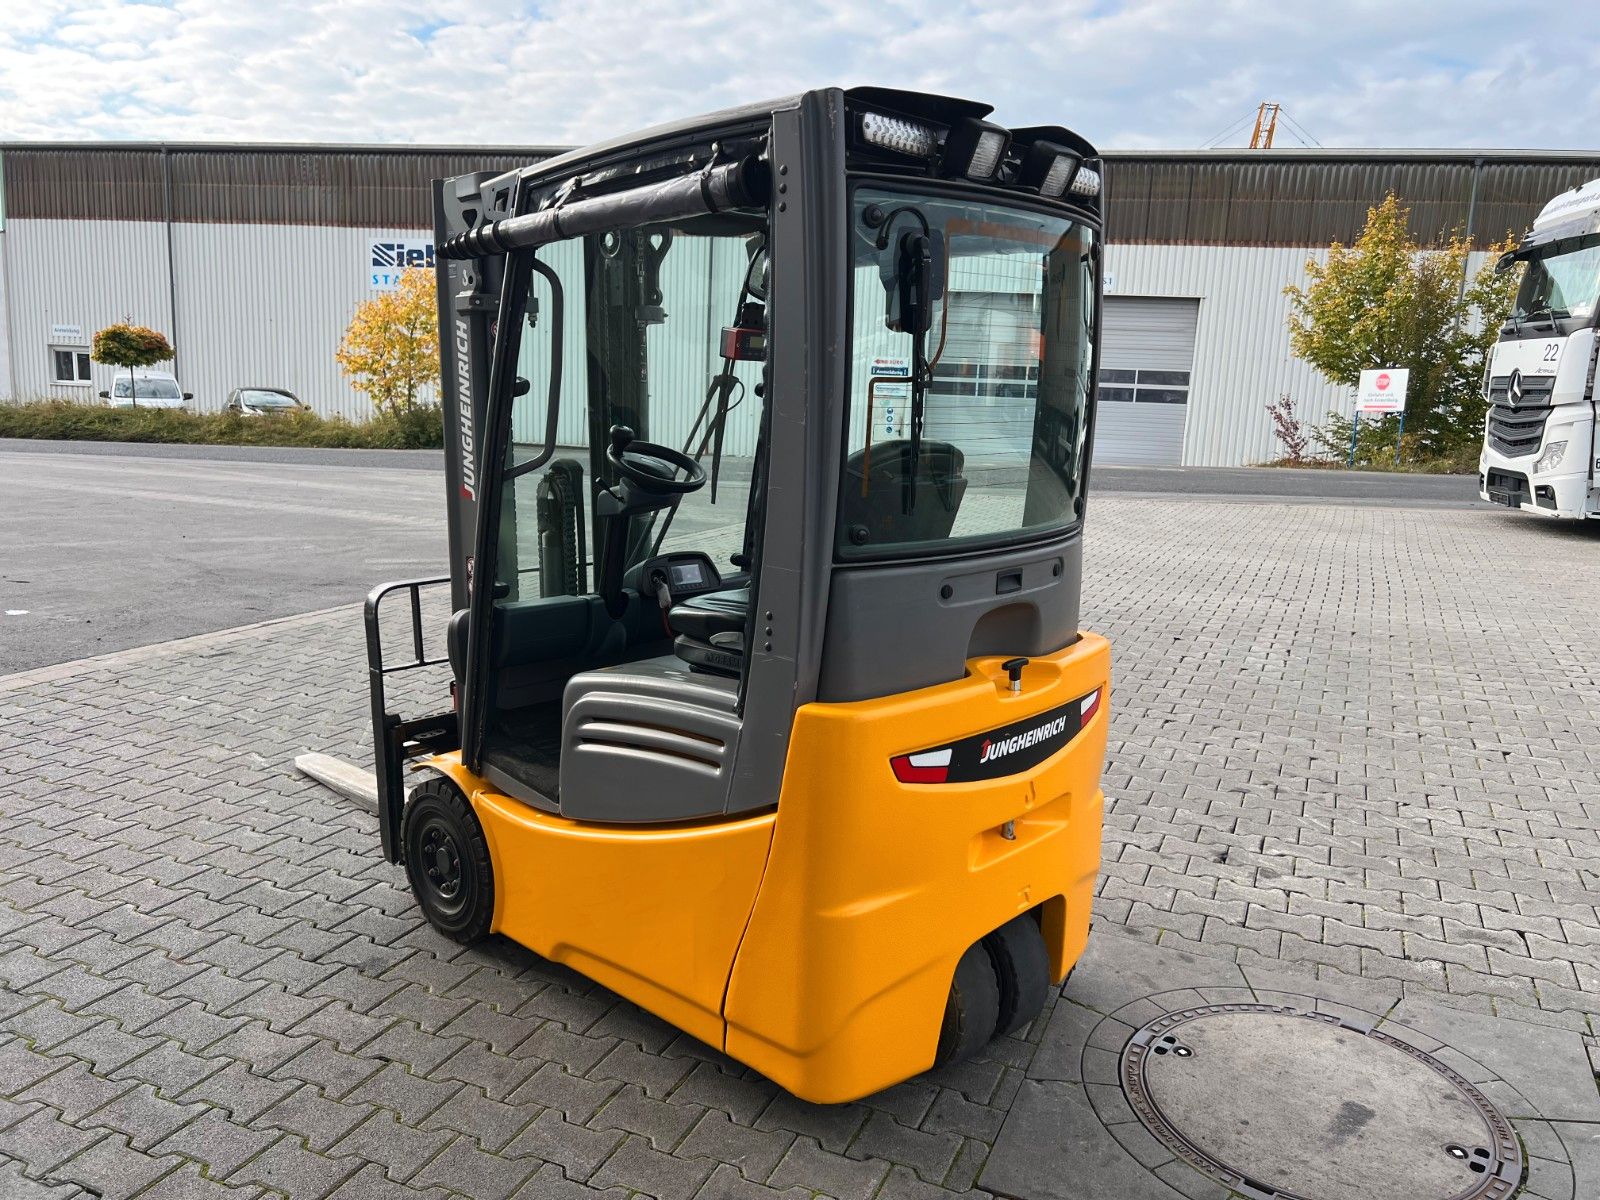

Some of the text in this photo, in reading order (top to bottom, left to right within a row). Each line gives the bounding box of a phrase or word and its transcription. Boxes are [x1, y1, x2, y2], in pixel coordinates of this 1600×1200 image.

[1543, 343, 1559, 361] 22
[455, 319, 476, 502] JUNGHEINRICH
[980, 715, 1066, 764] JUNGHEINRICH
